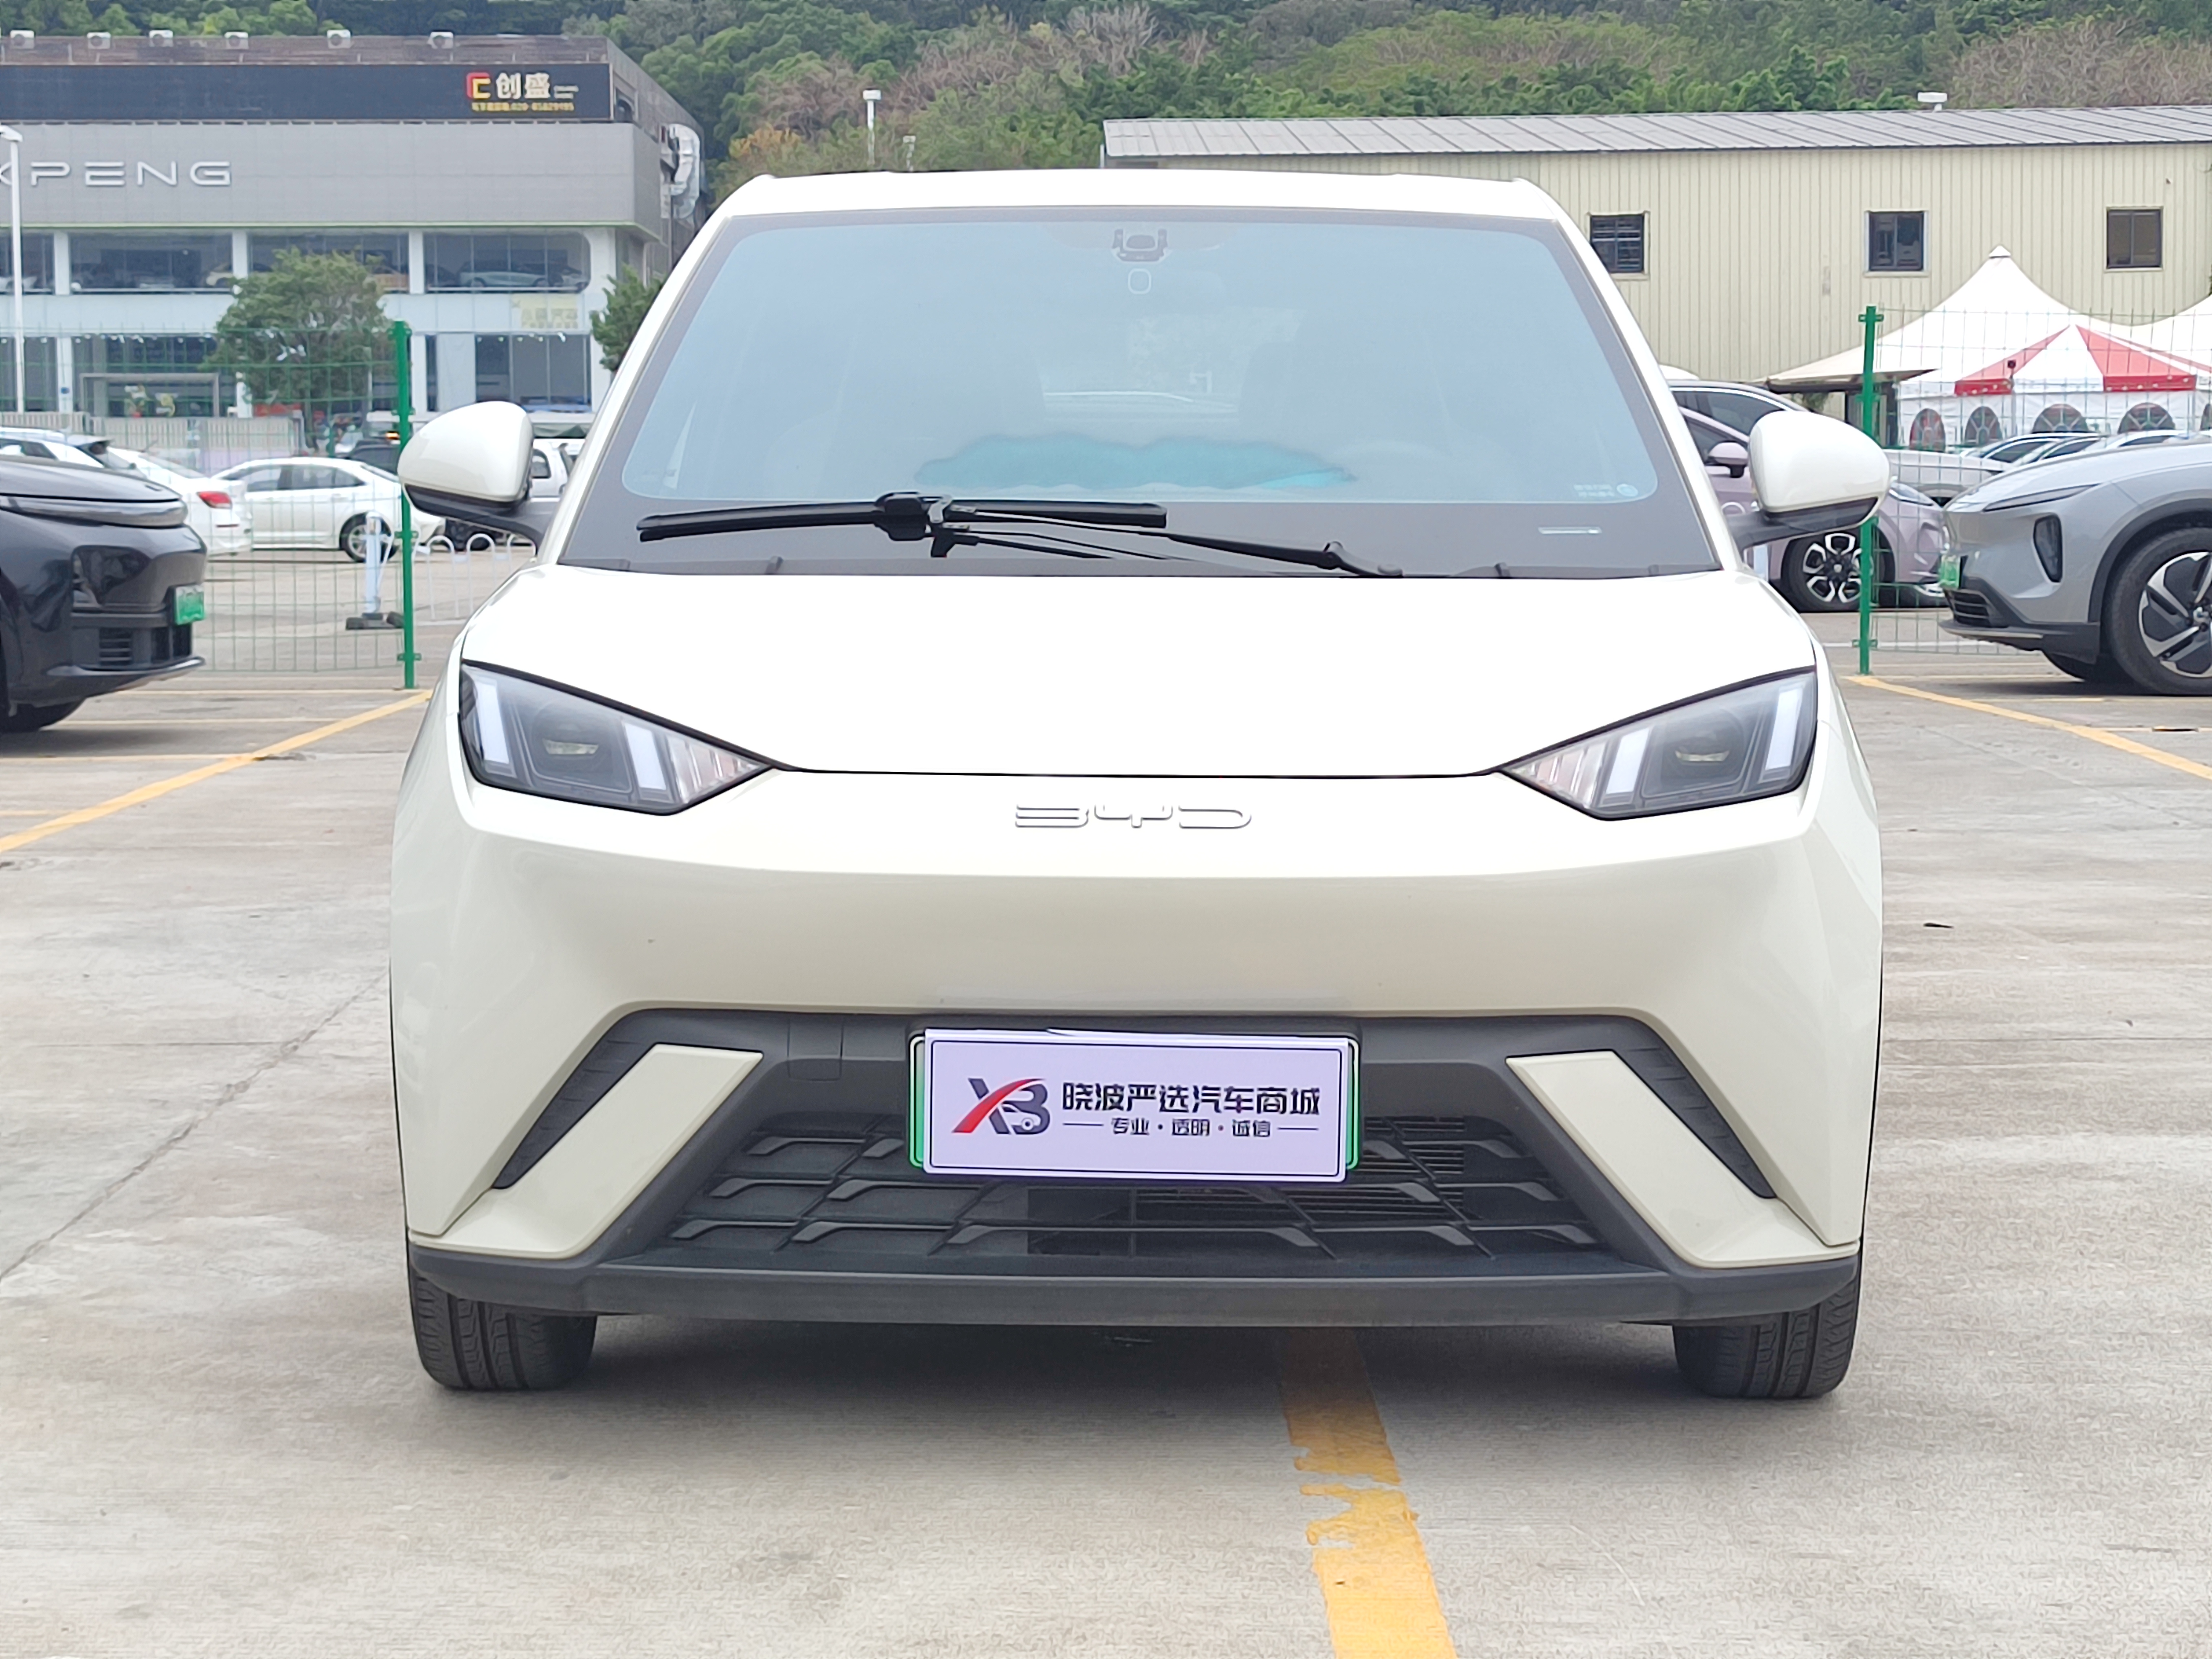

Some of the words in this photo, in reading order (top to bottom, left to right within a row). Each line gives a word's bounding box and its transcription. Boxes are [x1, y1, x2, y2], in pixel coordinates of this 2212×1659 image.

[496, 73, 550, 99] 创盛
[1015, 802, 1252, 829] BYD
[1062, 1082, 1320, 1115] 晓波严选汽车商城
